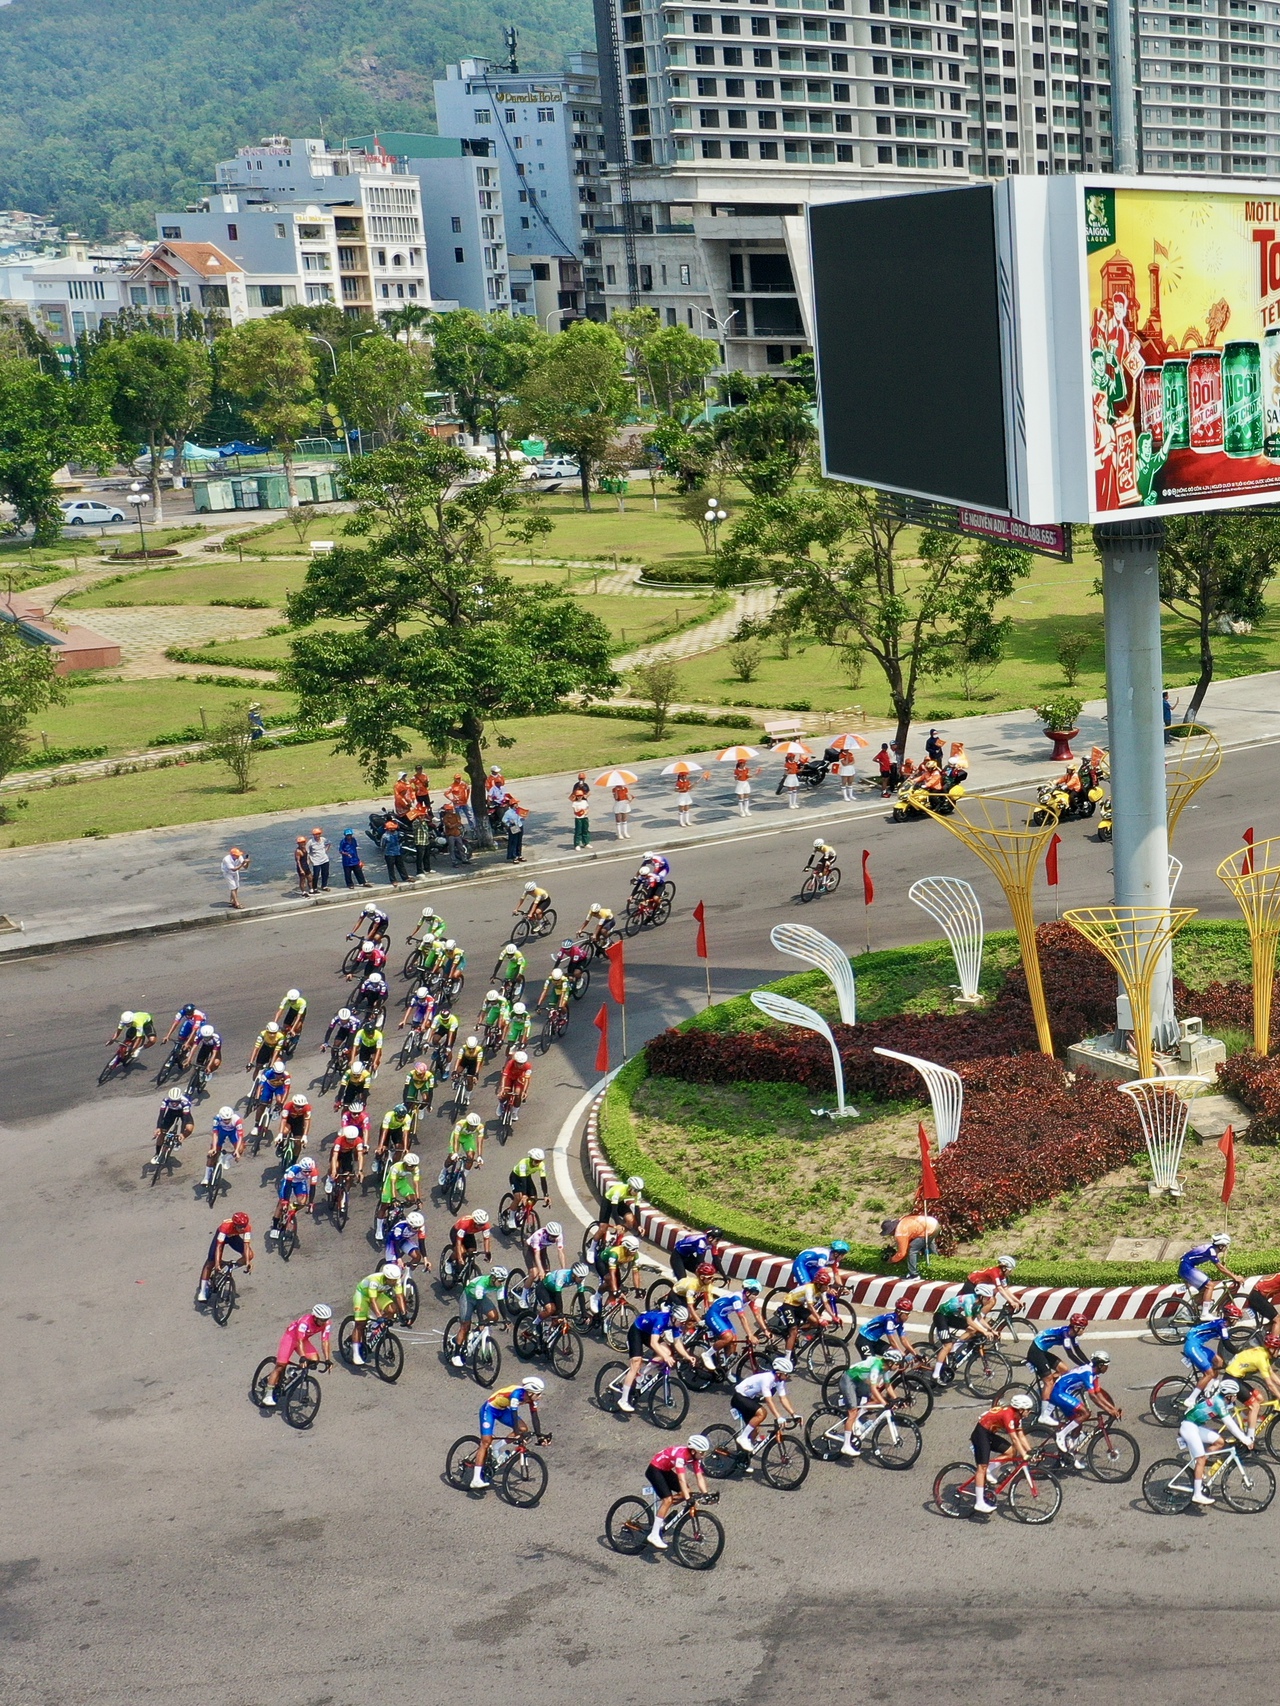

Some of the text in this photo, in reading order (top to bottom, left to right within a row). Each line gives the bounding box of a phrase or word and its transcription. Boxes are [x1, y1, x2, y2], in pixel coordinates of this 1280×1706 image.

[539, 91, 563, 102] Hotel
[1245, 201, 1271, 224] MỘT
[1085, 227, 1110, 237] SAIGON
[1164, 385, 1186, 412] GÓP
[961, 509, 969, 525] LÊ
[784, 1309, 796, 1325] EVR
